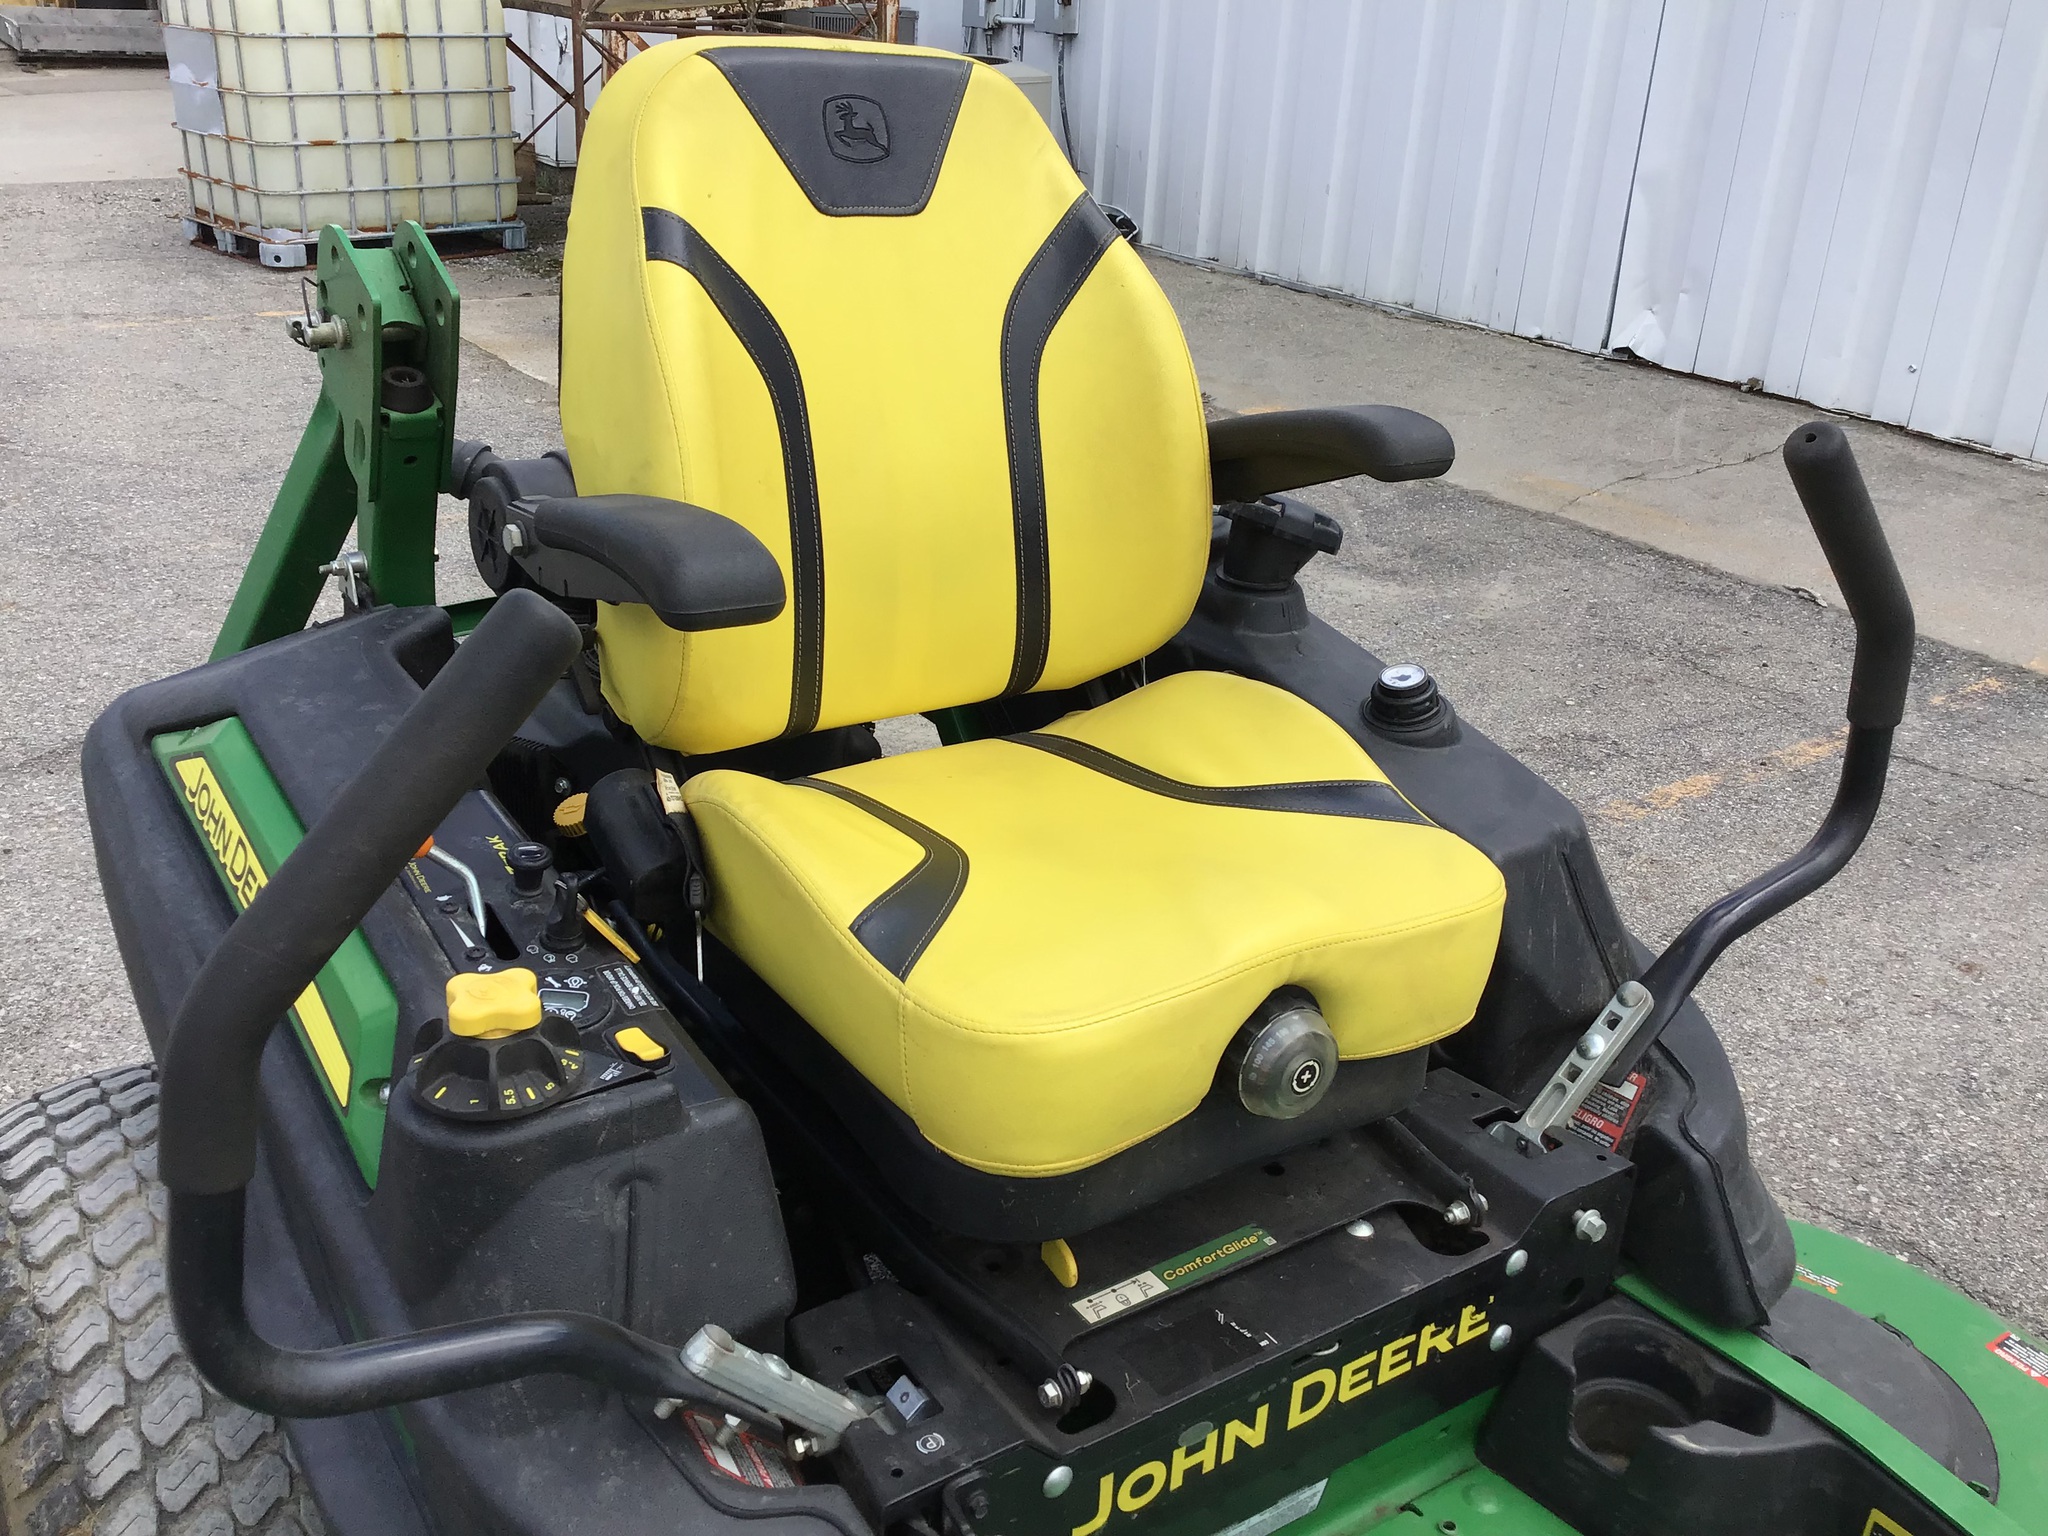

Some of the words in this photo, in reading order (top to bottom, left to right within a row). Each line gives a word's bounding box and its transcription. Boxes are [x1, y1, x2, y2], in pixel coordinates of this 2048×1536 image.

[188, 767, 233, 860] JOHN
[408, 862, 421, 876] JOHN
[416, 875, 432, 893] DEERE
[1252, 1053, 1264, 1068] 100
[503, 1089, 517, 1105] 5.5
[1071, 1403, 1269, 1536] JOHN
[1287, 1296, 1494, 1431] DEERE
